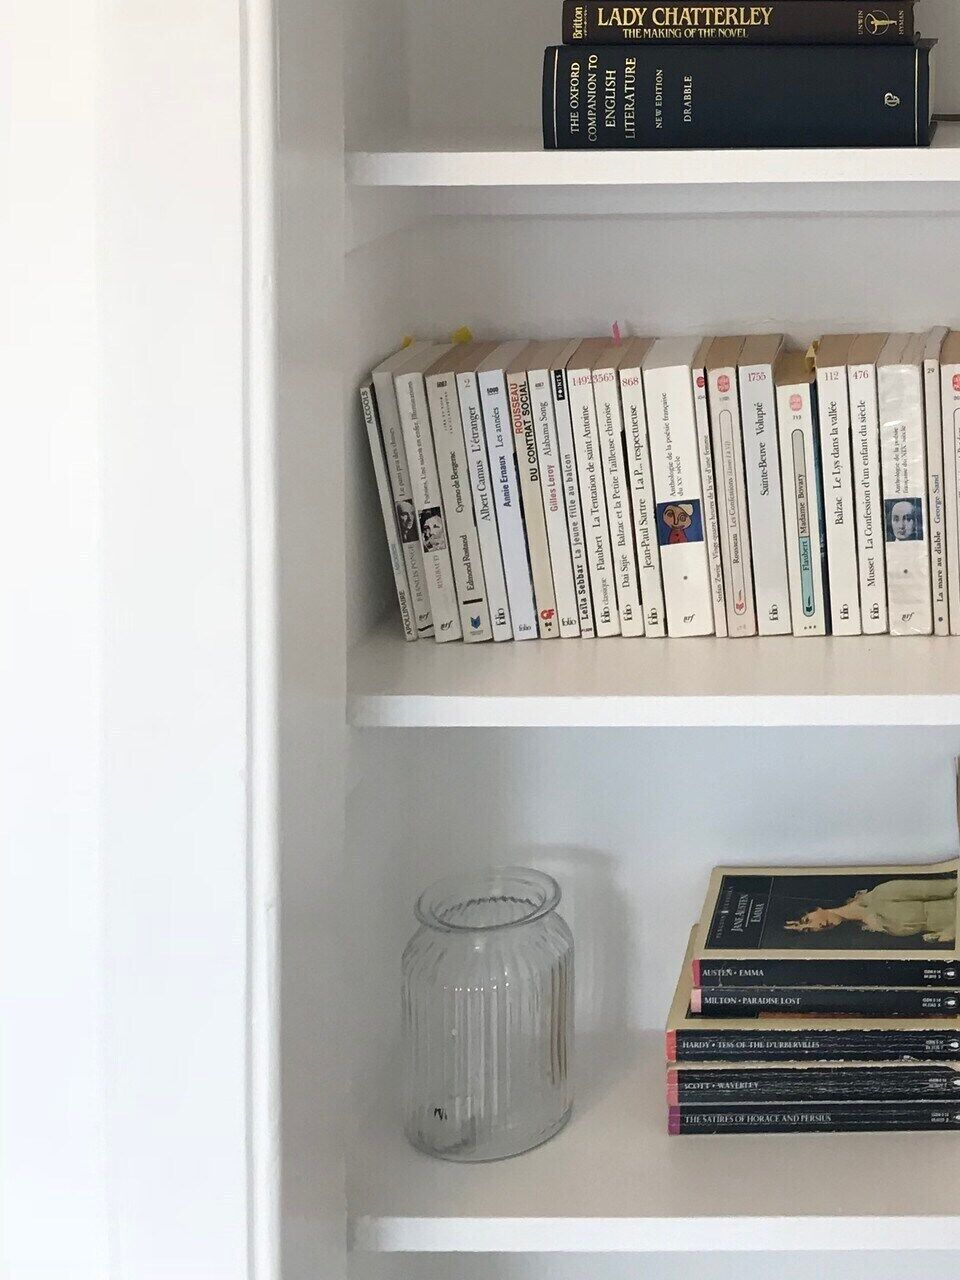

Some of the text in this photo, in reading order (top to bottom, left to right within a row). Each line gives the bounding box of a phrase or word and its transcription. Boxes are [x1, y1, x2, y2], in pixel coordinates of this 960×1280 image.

[572, 6, 583, 39] Britton
[597, 7, 648, 26] LADY
[652, 7, 774, 26] CHATTERLEY
[623, 28, 750, 39] THE MAKING OF THE NOVEL
[569, 62, 580, 135] THE OXFORD
[587, 54, 598, 142] COMPANION TO
[605, 70, 617, 128] ENGLISH
[624, 57, 637, 139] LITERATURE
[655, 69, 663, 129] NEW EDITION
[683, 75, 693, 123] DRABBLE
[361, 390, 374, 425] ALCOOLS
[491, 407, 504, 448] Les années
[509, 382, 523, 434] ROUSSEAU
[538, 401, 550, 422] Song
[519, 380, 539, 482] DU CONTRAT SOCIAL
[541, 422, 553, 457] Alabama
[629, 404, 643, 461] respectueuse
[754, 401, 770, 496] Sainte-Beuve Volupté
[467, 406, 491, 521] Albert Camus L'étranger
[497, 455, 512, 508] Annie Ernaux
[545, 464, 557, 487] Leroy
[827, 401, 844, 525] Balzac Le Lys dans la vallée
[547, 488, 558, 512] Gilles
[580, 405, 606, 571] Flaubert La Tentation de saint Antoine
[635, 478, 645, 491] La
[857, 400, 876, 587] Musset La Confession d'un enfant du siècle
[931, 475, 940, 494] Sand
[637, 498, 649, 525] Sartre
[727, 477, 741, 564] Rousseau Les Confessions
[796, 473, 810, 571] Flaubert Madame Bovary
[932, 496, 943, 524] George
[460, 534, 475, 590] Edmond Rostand
[640, 527, 655, 570] Jean-Paul
[933, 531, 942, 555] diable
[936, 557, 942, 567] au
[398, 589, 413, 635] APOLLINAIRE
[936, 591, 944, 602] La
[702, 969, 765, 977] AUSTEN EMMA
[704, 997, 802, 1005] MILTON PARADISE LOST
[682, 1041, 820, 1049] HARDY TESS OF THE D'URBERVILLES
[717, 1082, 759, 1090] WAVERLEY
